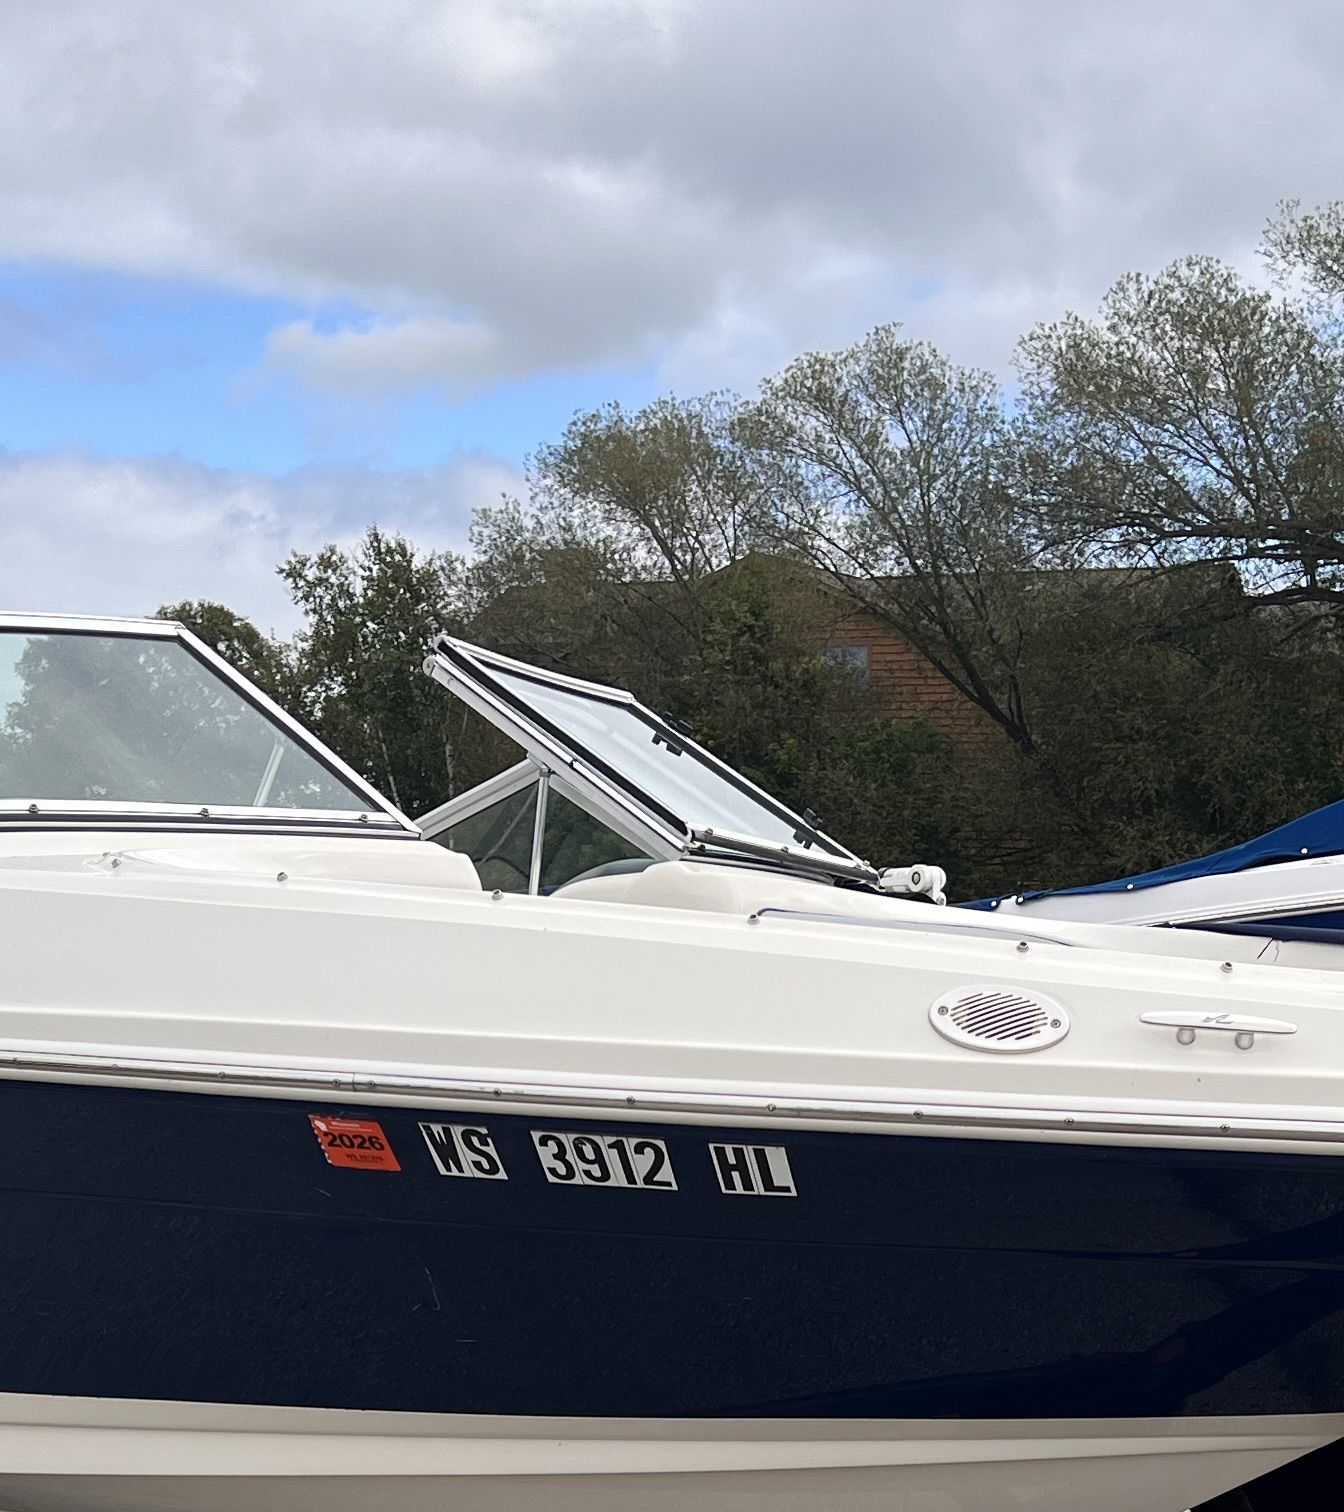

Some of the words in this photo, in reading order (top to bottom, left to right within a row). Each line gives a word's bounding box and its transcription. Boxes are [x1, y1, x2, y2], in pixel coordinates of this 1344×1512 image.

[323, 1131, 385, 1152] 2026
[422, 1123, 502, 1177] WS
[537, 1135, 673, 1188] 3912
[713, 1145, 792, 1194] HL
